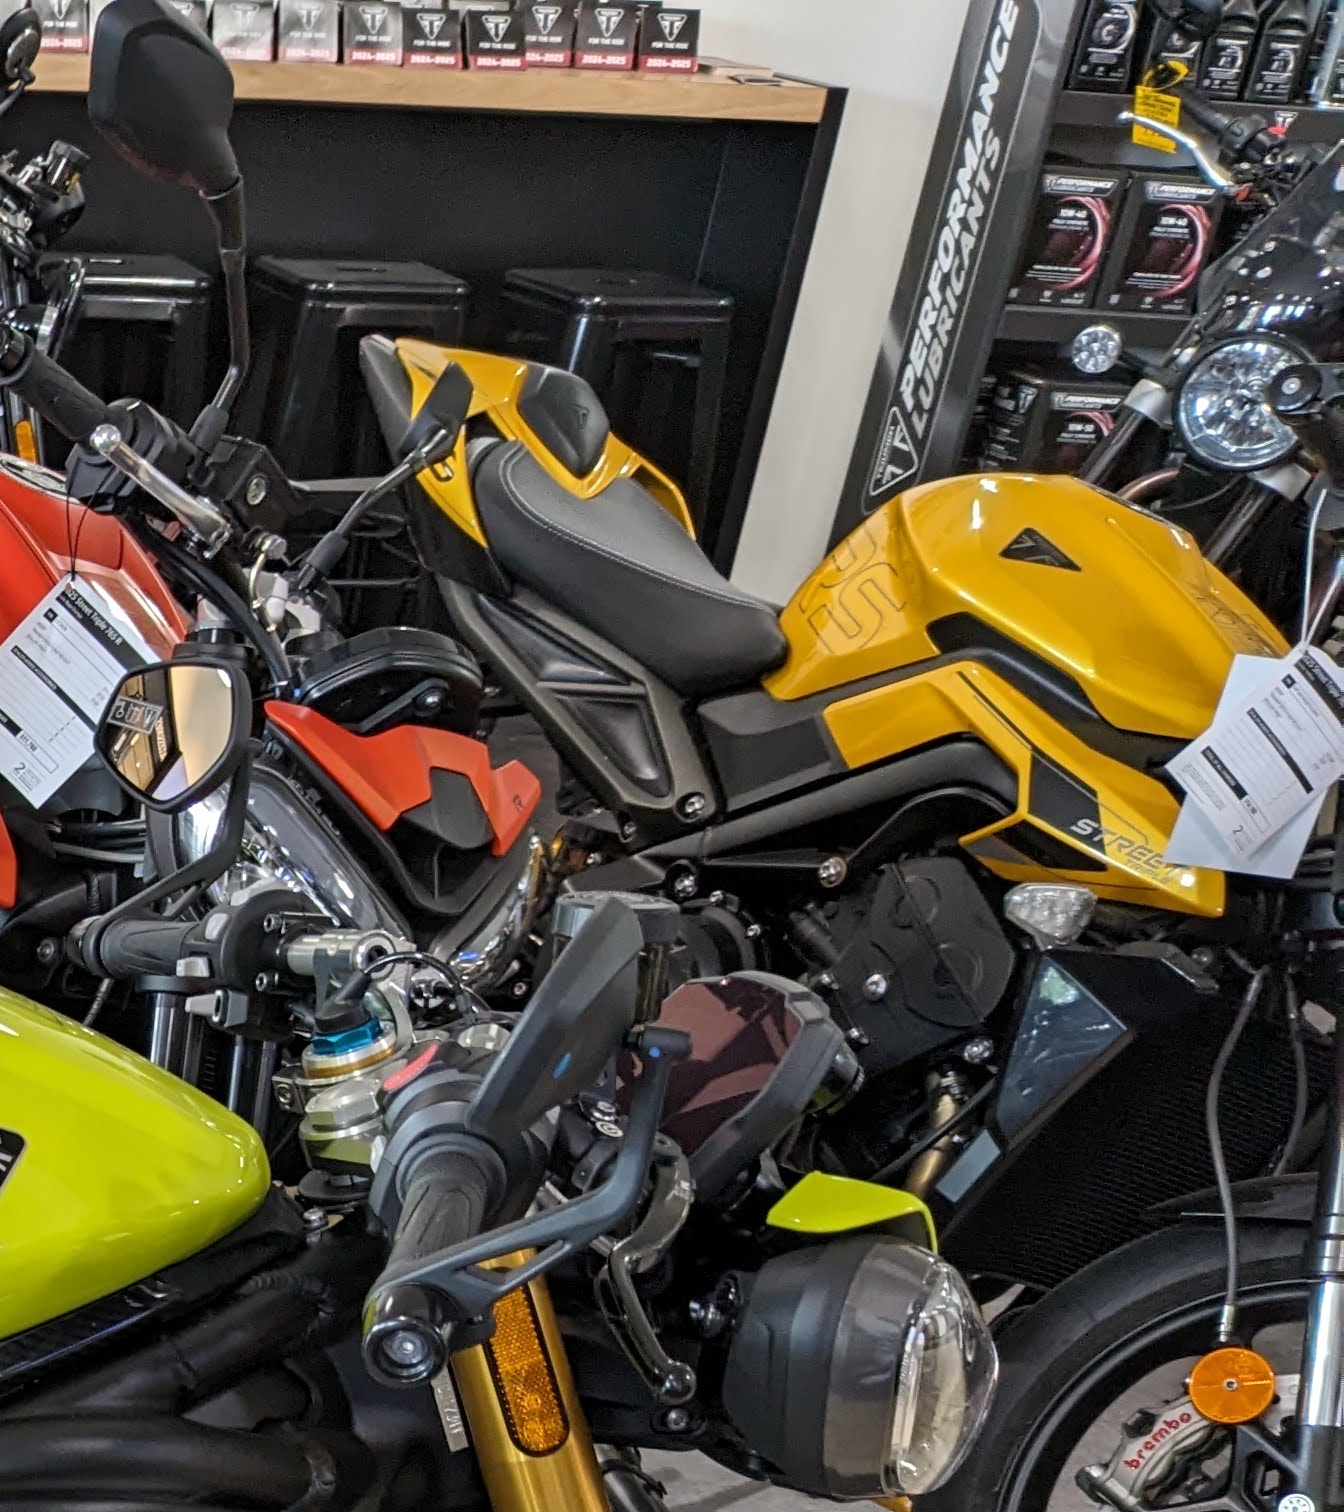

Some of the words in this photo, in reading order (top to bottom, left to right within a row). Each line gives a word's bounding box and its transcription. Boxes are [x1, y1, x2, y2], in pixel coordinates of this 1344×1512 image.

[526, 52, 564, 62] 024-2025
[900, 0, 1020, 413] PERFORMANCE
[911, 127, 1000, 439] LUBRICANTS
[1123, 1412, 1192, 1470] brembo
